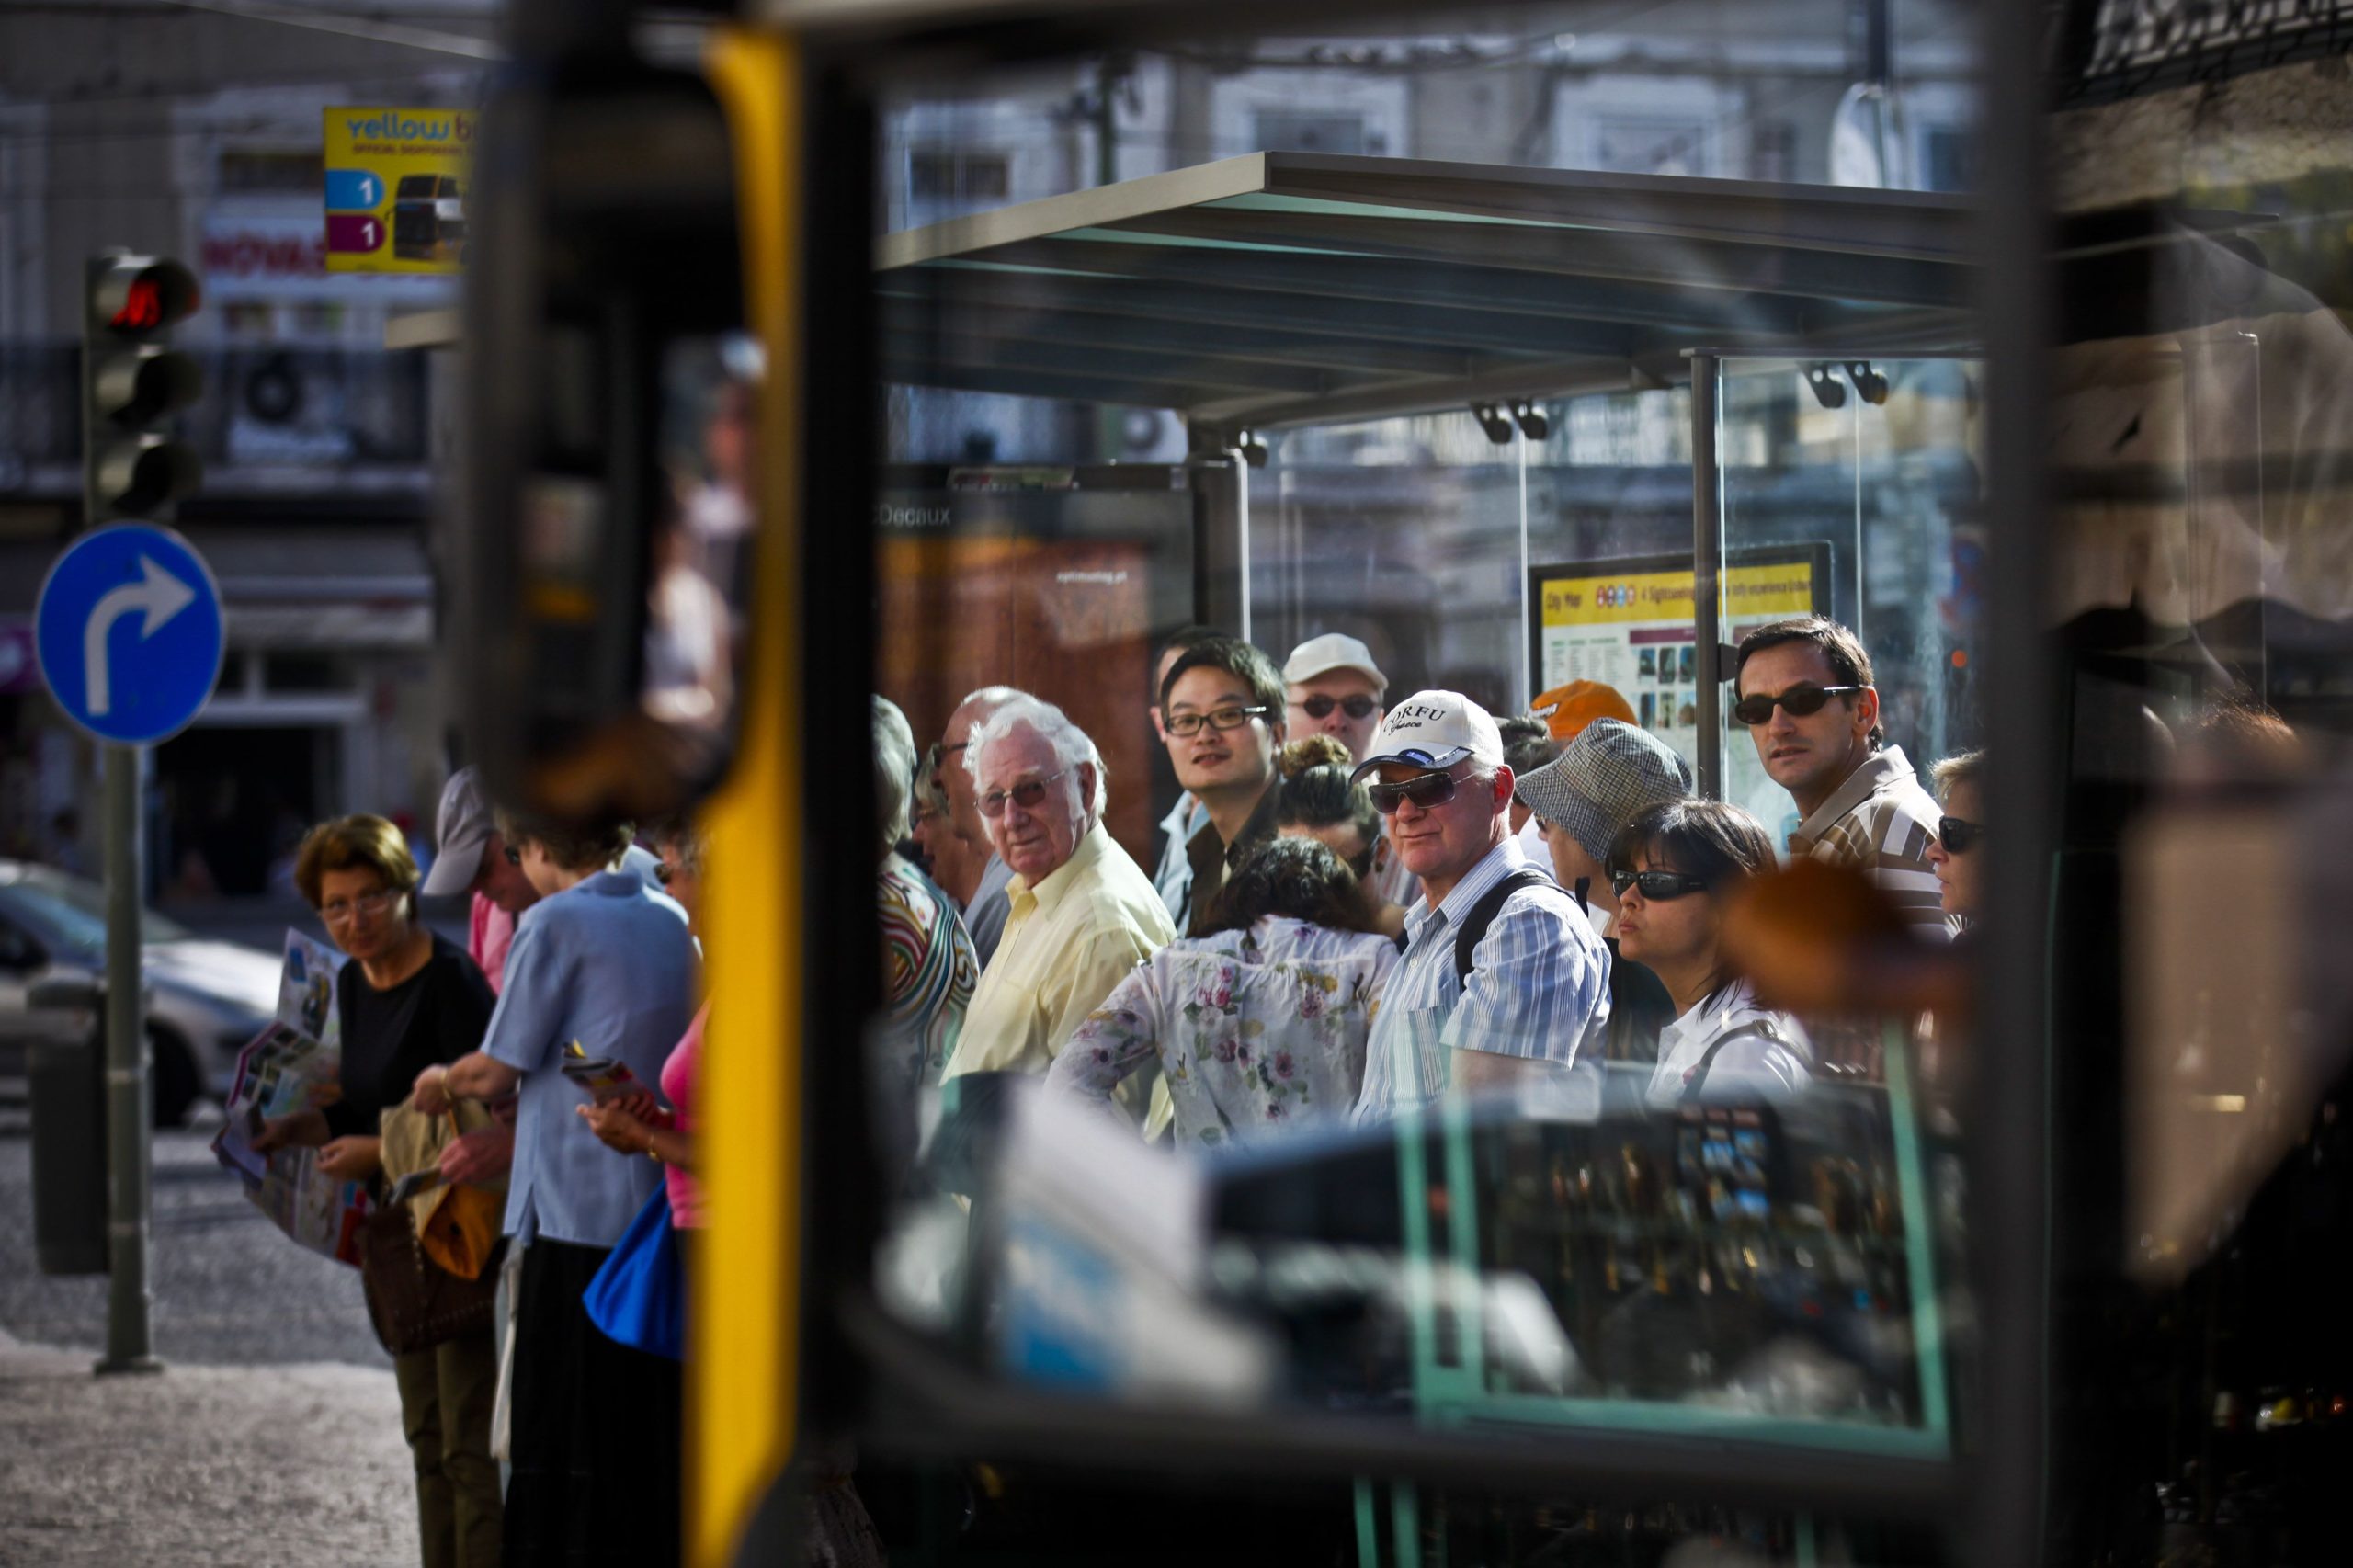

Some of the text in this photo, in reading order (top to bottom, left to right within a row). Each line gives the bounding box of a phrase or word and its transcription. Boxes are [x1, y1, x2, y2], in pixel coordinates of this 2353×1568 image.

[358, 179, 373, 205] 1
[361, 221, 376, 247] 1
[1382, 705, 1447, 733] CORFU
